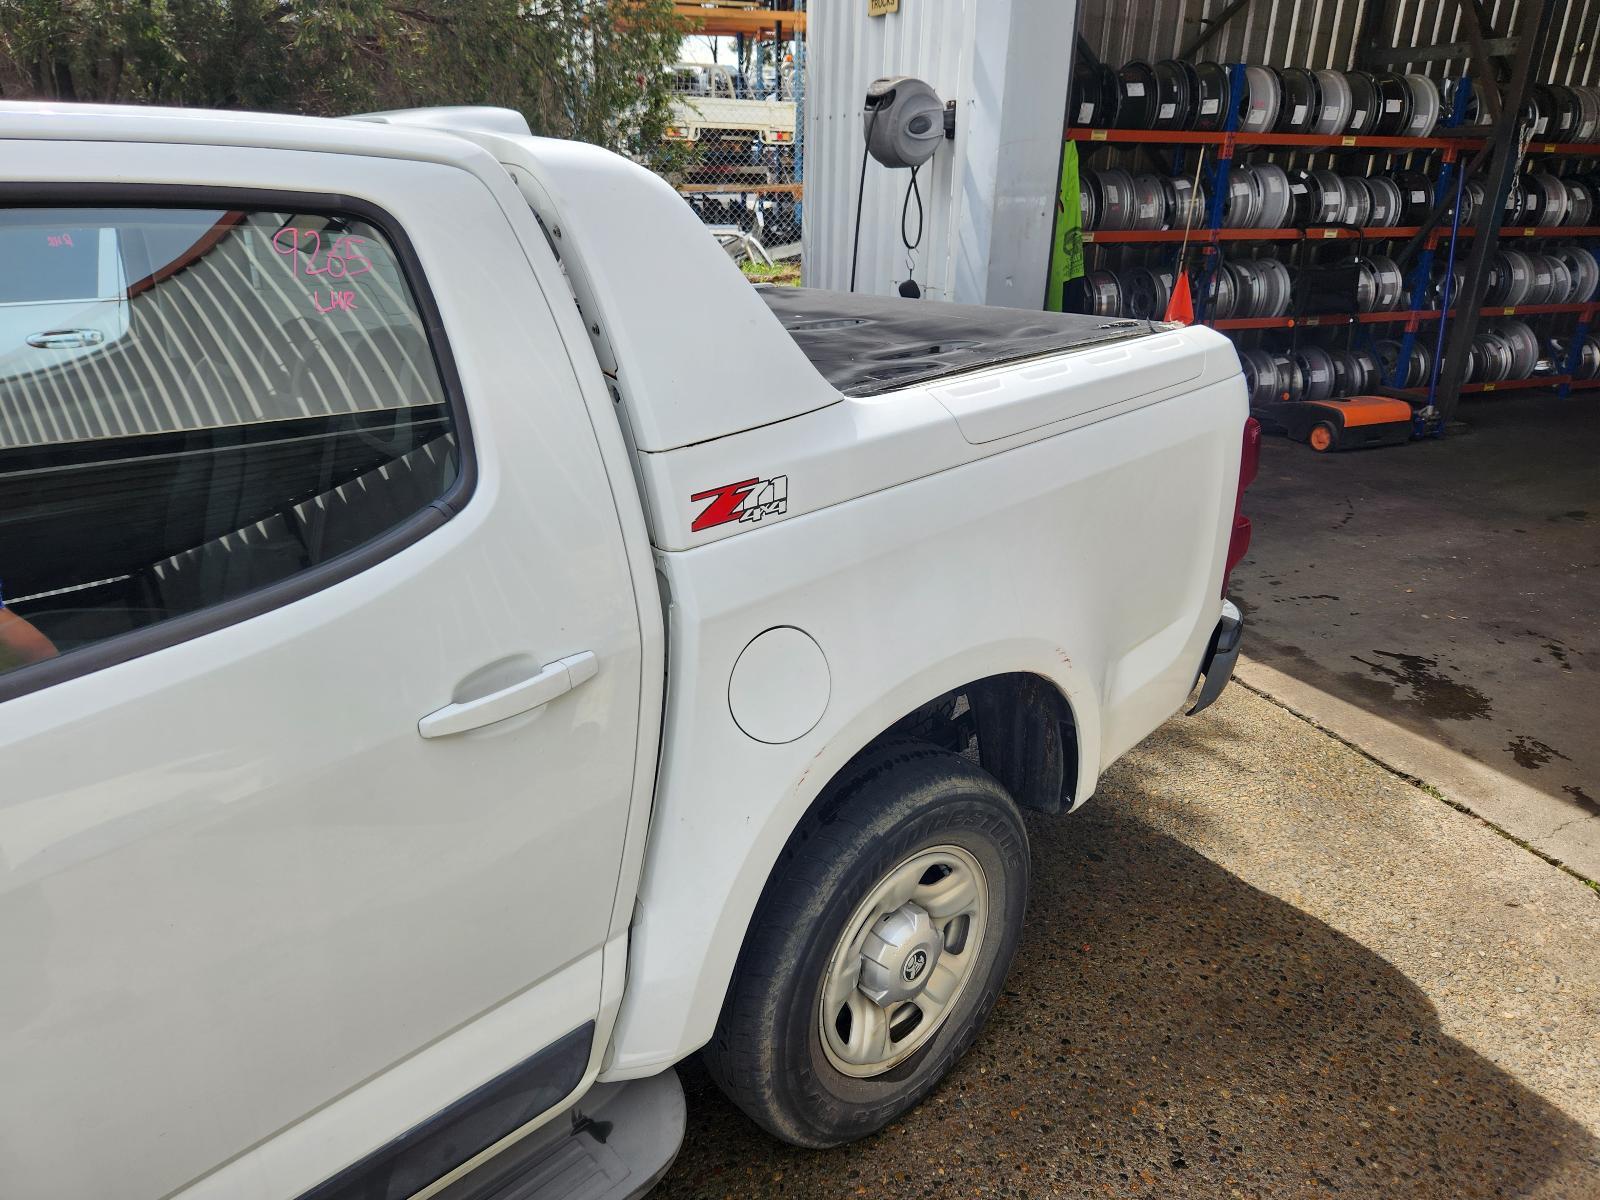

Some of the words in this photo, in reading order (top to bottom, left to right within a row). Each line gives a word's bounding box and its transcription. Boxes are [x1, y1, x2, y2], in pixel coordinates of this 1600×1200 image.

[273, 227, 373, 277] 9265
[314, 289, 359, 314] LHR
[690, 475, 788, 533] Z71
